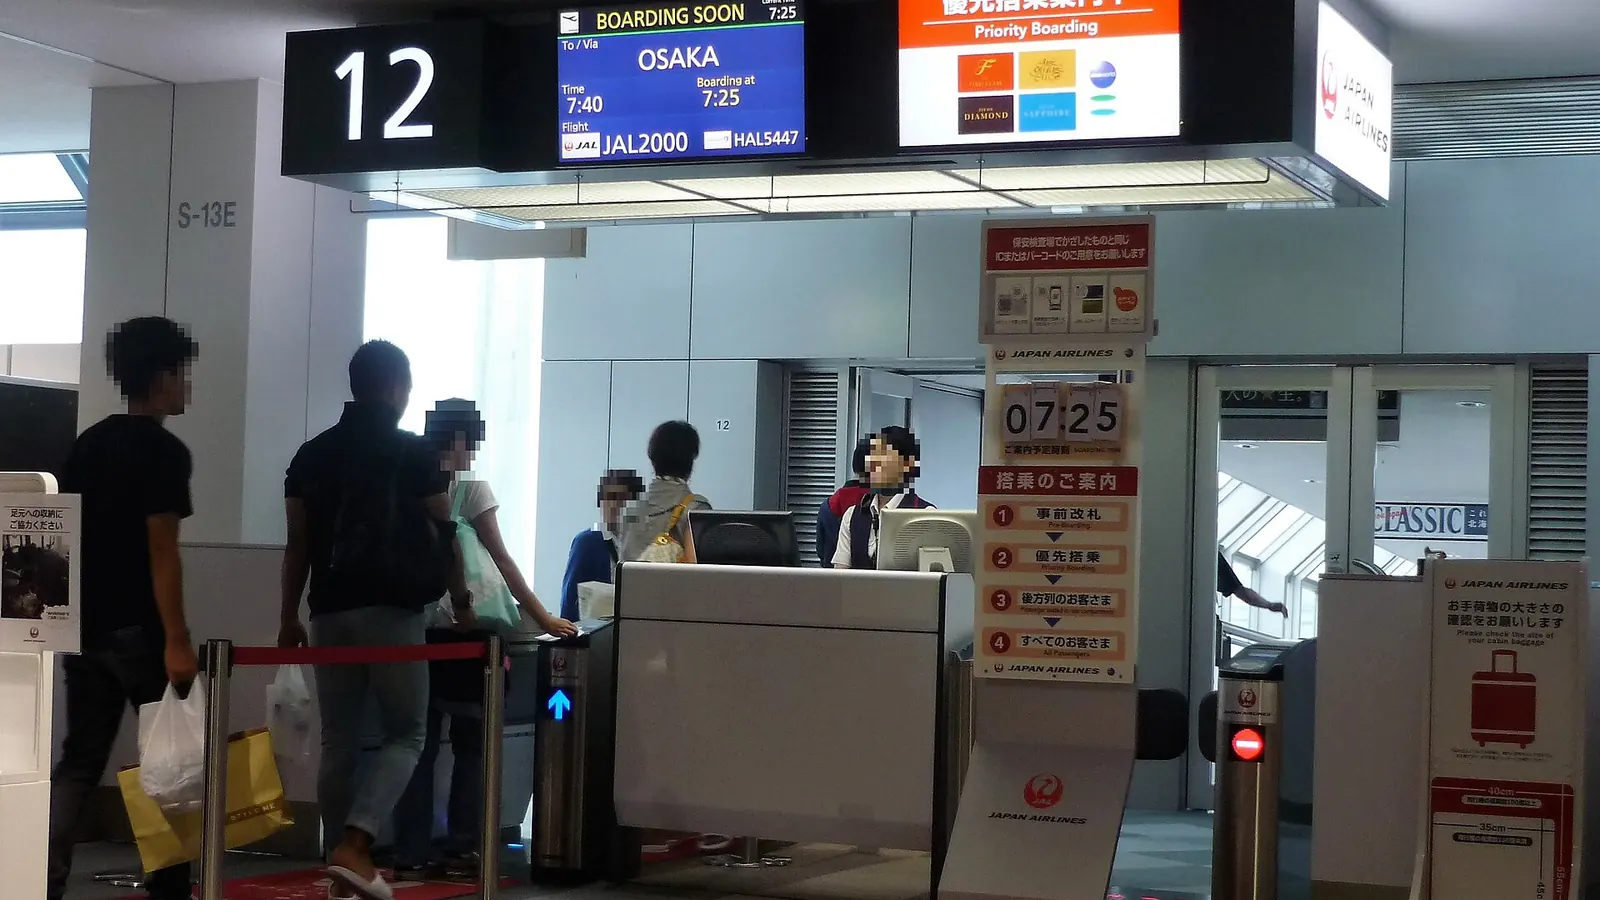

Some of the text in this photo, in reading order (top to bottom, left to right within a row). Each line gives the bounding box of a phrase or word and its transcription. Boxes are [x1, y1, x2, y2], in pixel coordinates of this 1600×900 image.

[596, 4, 745, 30] BOARDING SOON
[769, 6, 797, 20] 7:25
[975, 20, 1098, 40] Priority Boarding
[562, 40, 574, 51] To
[583, 39, 599, 50] Via
[638, 46, 720, 71] OSAKA
[697, 75, 755, 88] Boarding at
[334, 47, 435, 141] 12
[562, 85, 585, 94] Time
[1343, 73, 1375, 111] JAPAN
[702, 88, 740, 107] 7:25
[567, 96, 603, 114] 7:40
[963, 112, 1009, 121] DIAMOND
[562, 121, 589, 133] Flight
[1344, 106, 1389, 153] AIRLINES
[575, 141, 598, 150] JAL
[603, 132, 689, 155] JAL2000
[734, 130, 799, 148] HAL5447
[178, 201, 237, 229] S-13E
[1011, 349, 1114, 358] JAPAN AIRLINES
[1006, 401, 1118, 434] 07:25
[716, 420, 730, 430] 12
[996, 471, 1118, 491] 搭乗のご案内
[998, 509, 1006, 522] 1
[1036, 508, 1102, 521] 事前改札
[9, 520, 64, 531] ご協力ください
[997, 552, 1007, 565] 2
[1035, 550, 1101, 563] 優先搭乗
[1461, 580, 1569, 590] JAPAN AIRLINES
[996, 594, 1006, 607] 3
[1021, 592, 1112, 606] 後方列のお客さま
[1447, 600, 1565, 614] お手荷物の大きさの
[1447, 614, 1565, 628] 確認をお願いします
[994, 636, 1004, 649] 4
[1021, 635, 1111, 649] すべてのお客さま
[1008, 664, 1100, 675] JAPAN AIRLINES
[1487, 786, 1515, 796] 40cm
[988, 812, 1088, 825] JAPAN AIRLINES
[1479, 822, 1506, 833] 35cm
[1556, 866, 1566, 893] 55cm
[1536, 881, 1545, 900] 45c
